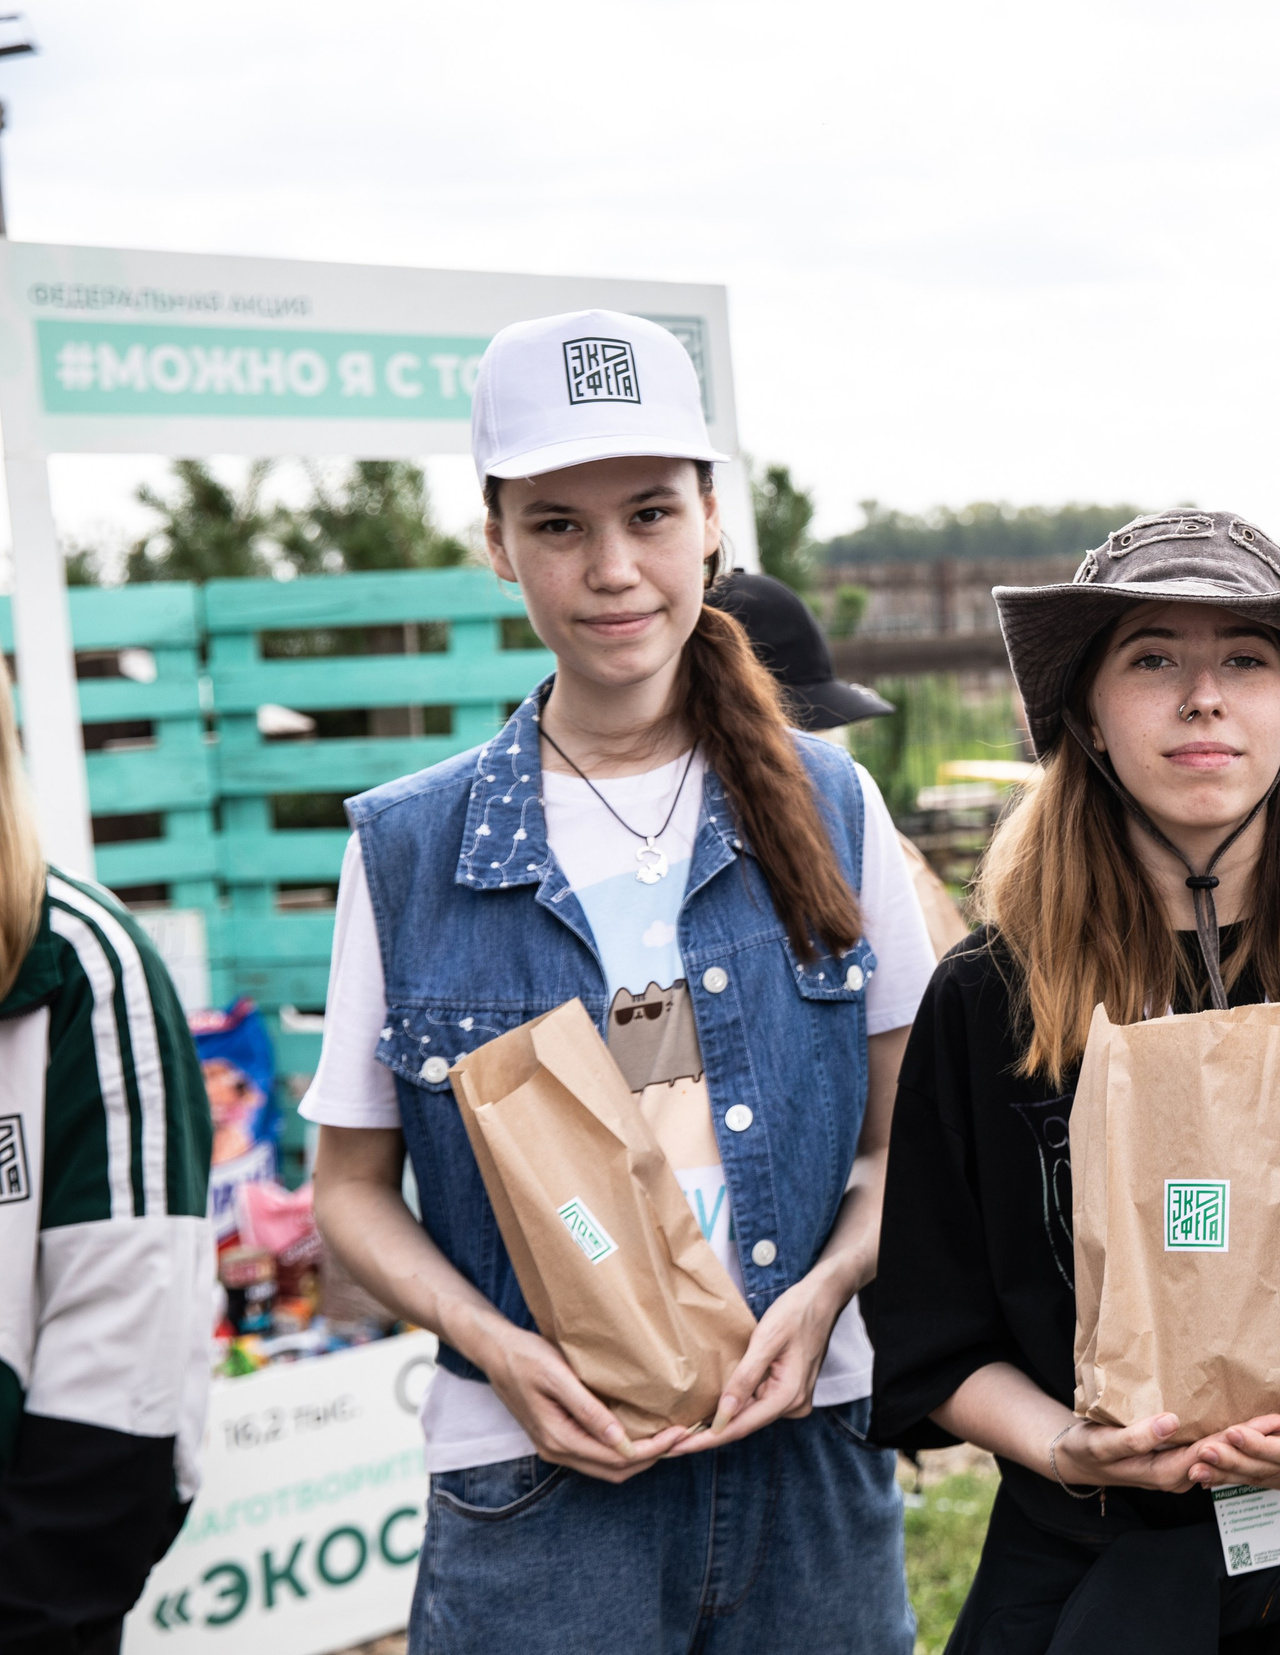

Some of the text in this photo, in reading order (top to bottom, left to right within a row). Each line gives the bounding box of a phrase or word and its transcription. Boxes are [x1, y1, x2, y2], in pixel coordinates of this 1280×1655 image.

[57, 343, 329, 396] #МОЖНО
[337, 350, 376, 398] Я
[384, 352, 423, 400] С
